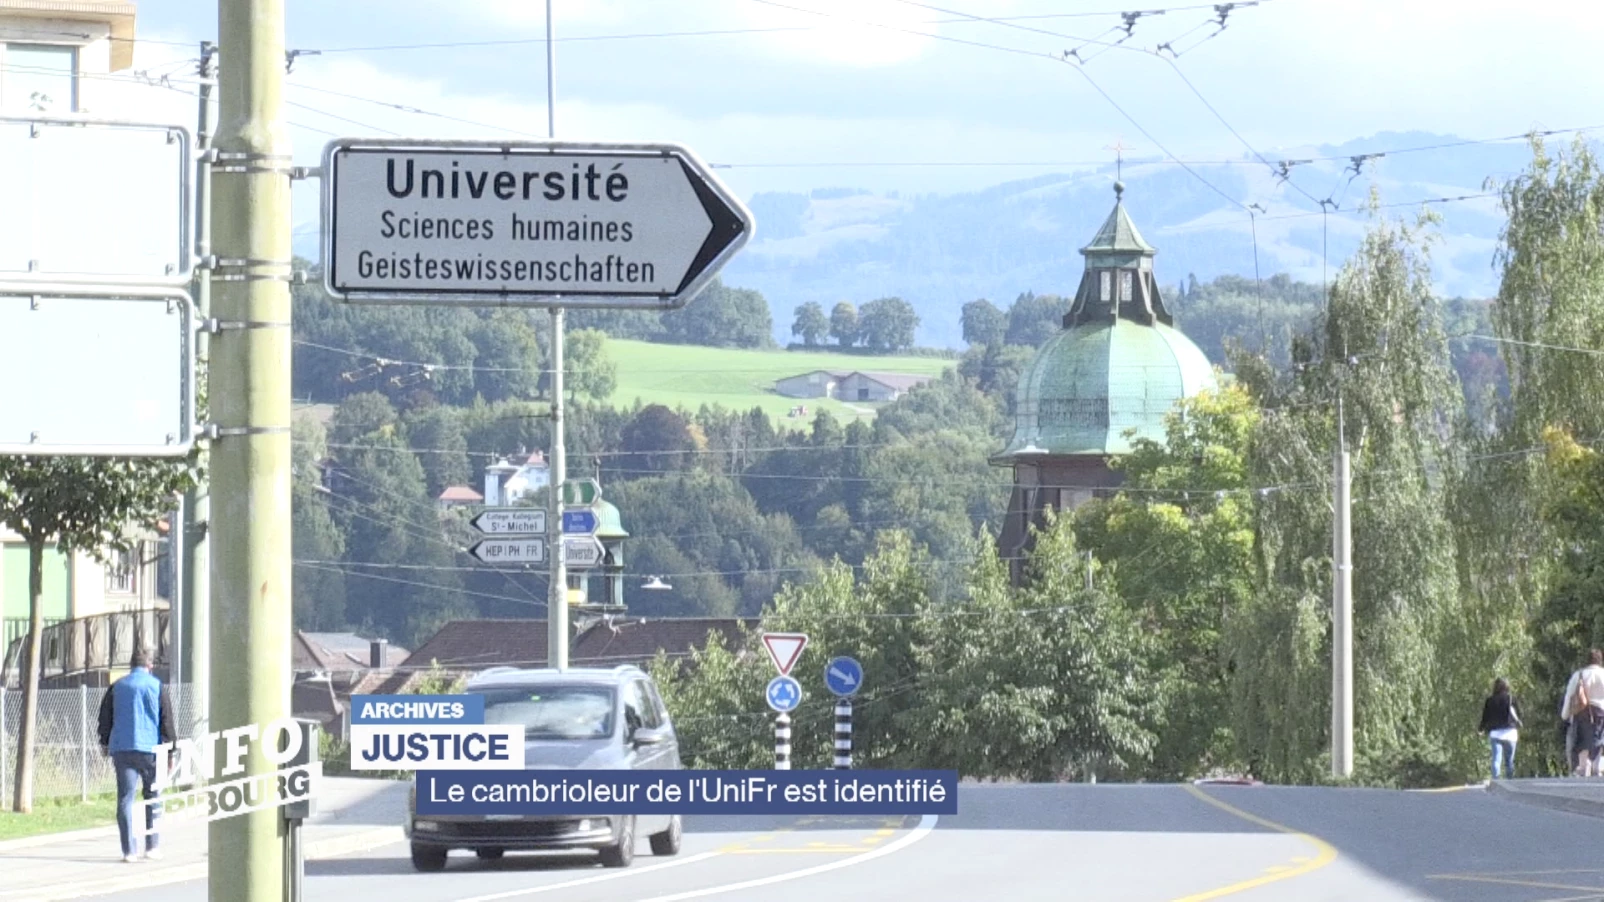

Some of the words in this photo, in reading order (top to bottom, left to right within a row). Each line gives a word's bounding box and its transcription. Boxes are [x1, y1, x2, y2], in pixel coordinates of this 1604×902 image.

[386, 158, 629, 202] Université
[380, 210, 494, 240] Sciences
[511, 213, 633, 242] humaines
[358, 250, 655, 283] Geisteswissenschaften
